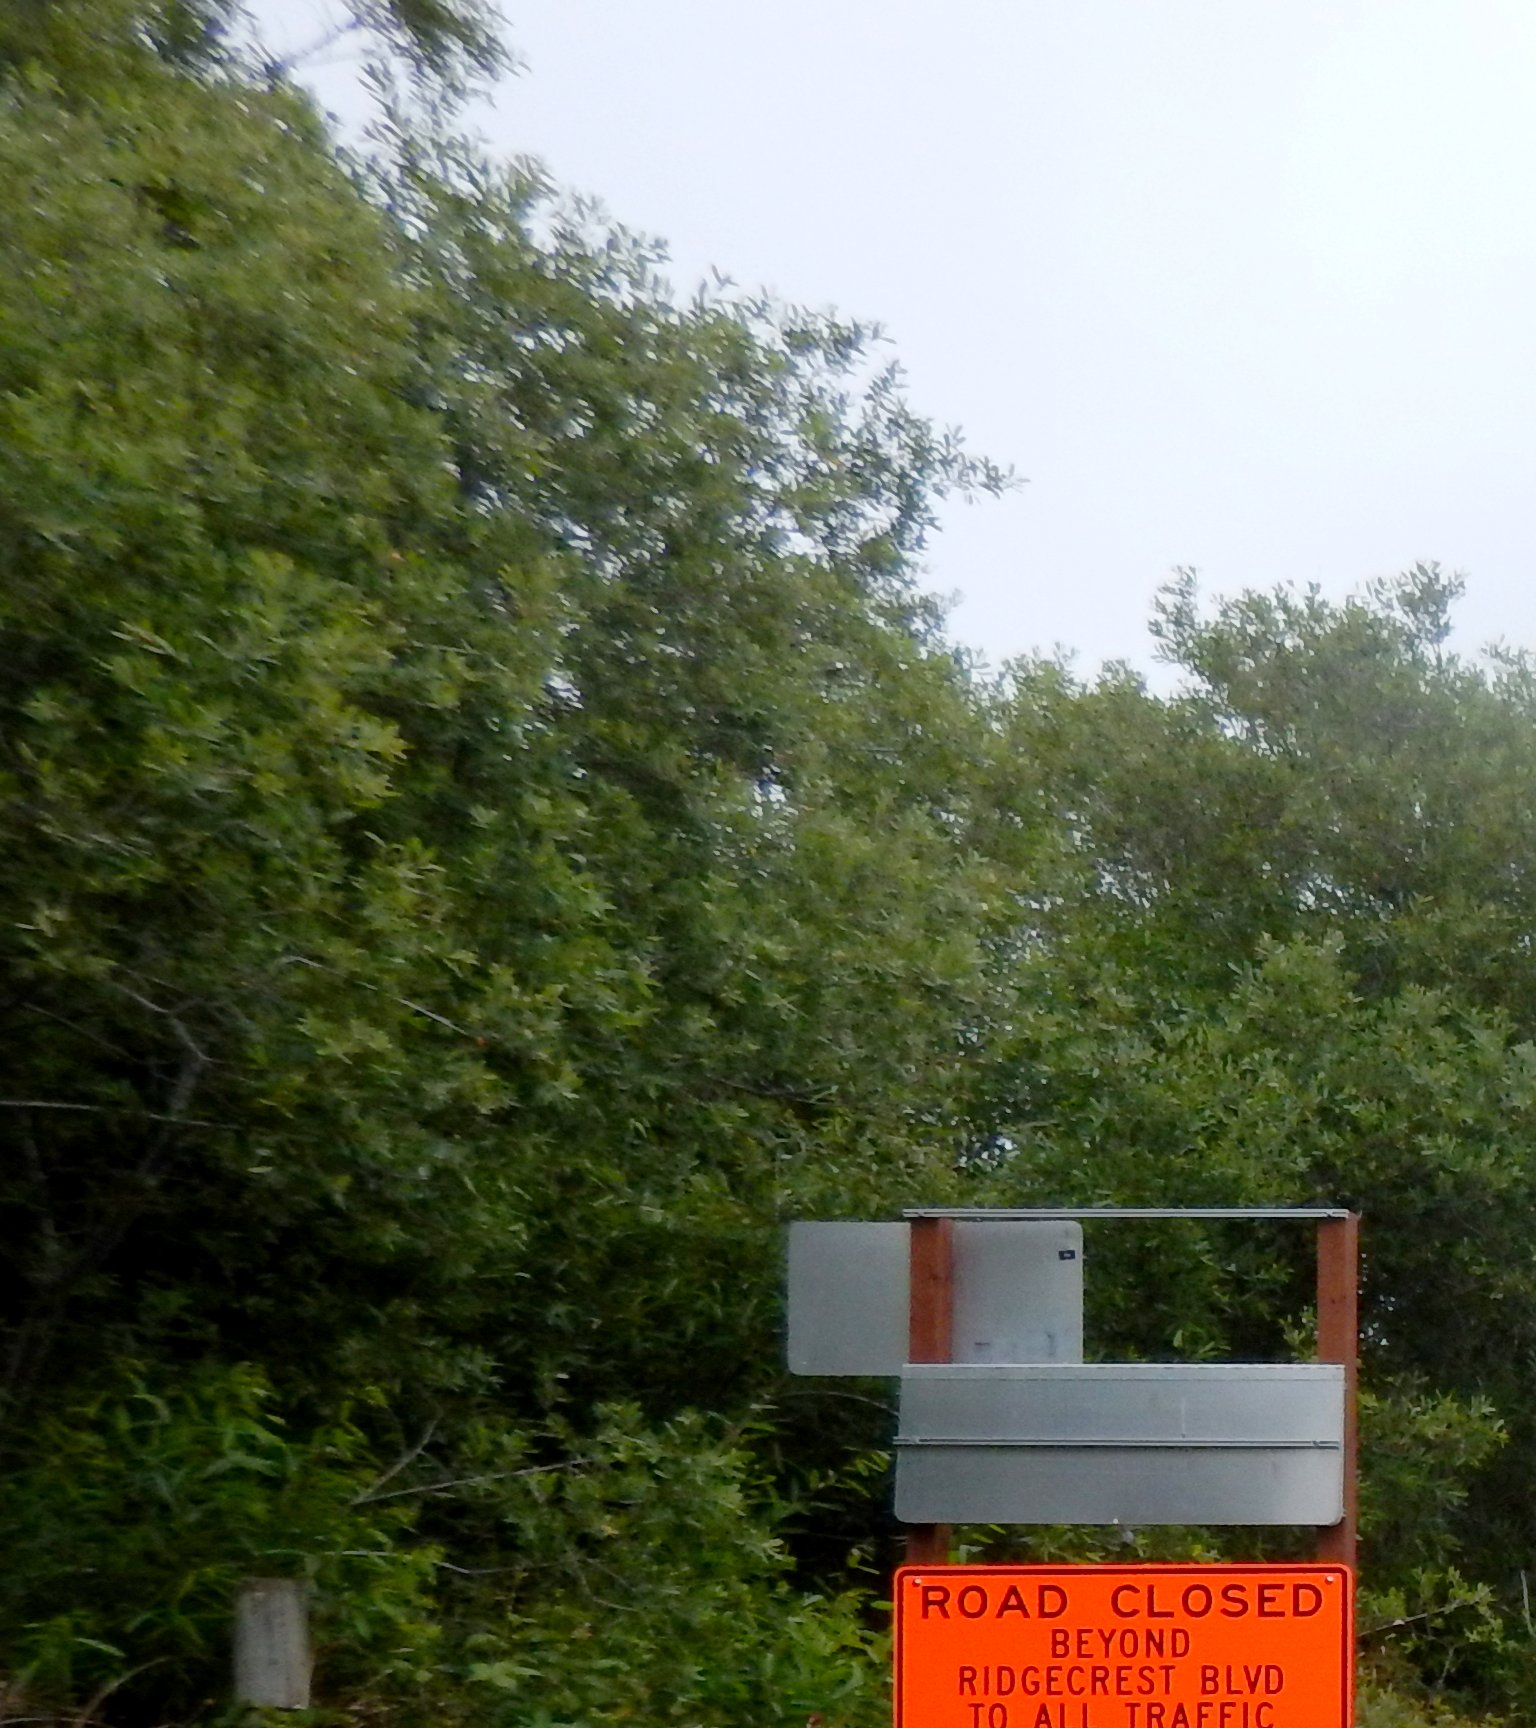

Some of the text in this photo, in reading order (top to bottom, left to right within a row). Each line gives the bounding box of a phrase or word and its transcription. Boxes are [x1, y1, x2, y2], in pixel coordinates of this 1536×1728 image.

[921, 1583, 1323, 1619] ROAD CLOSED
[1051, 1628, 1190, 1659] BEYOND
[959, 1664, 1284, 1696] RIDGECREST BLVD
